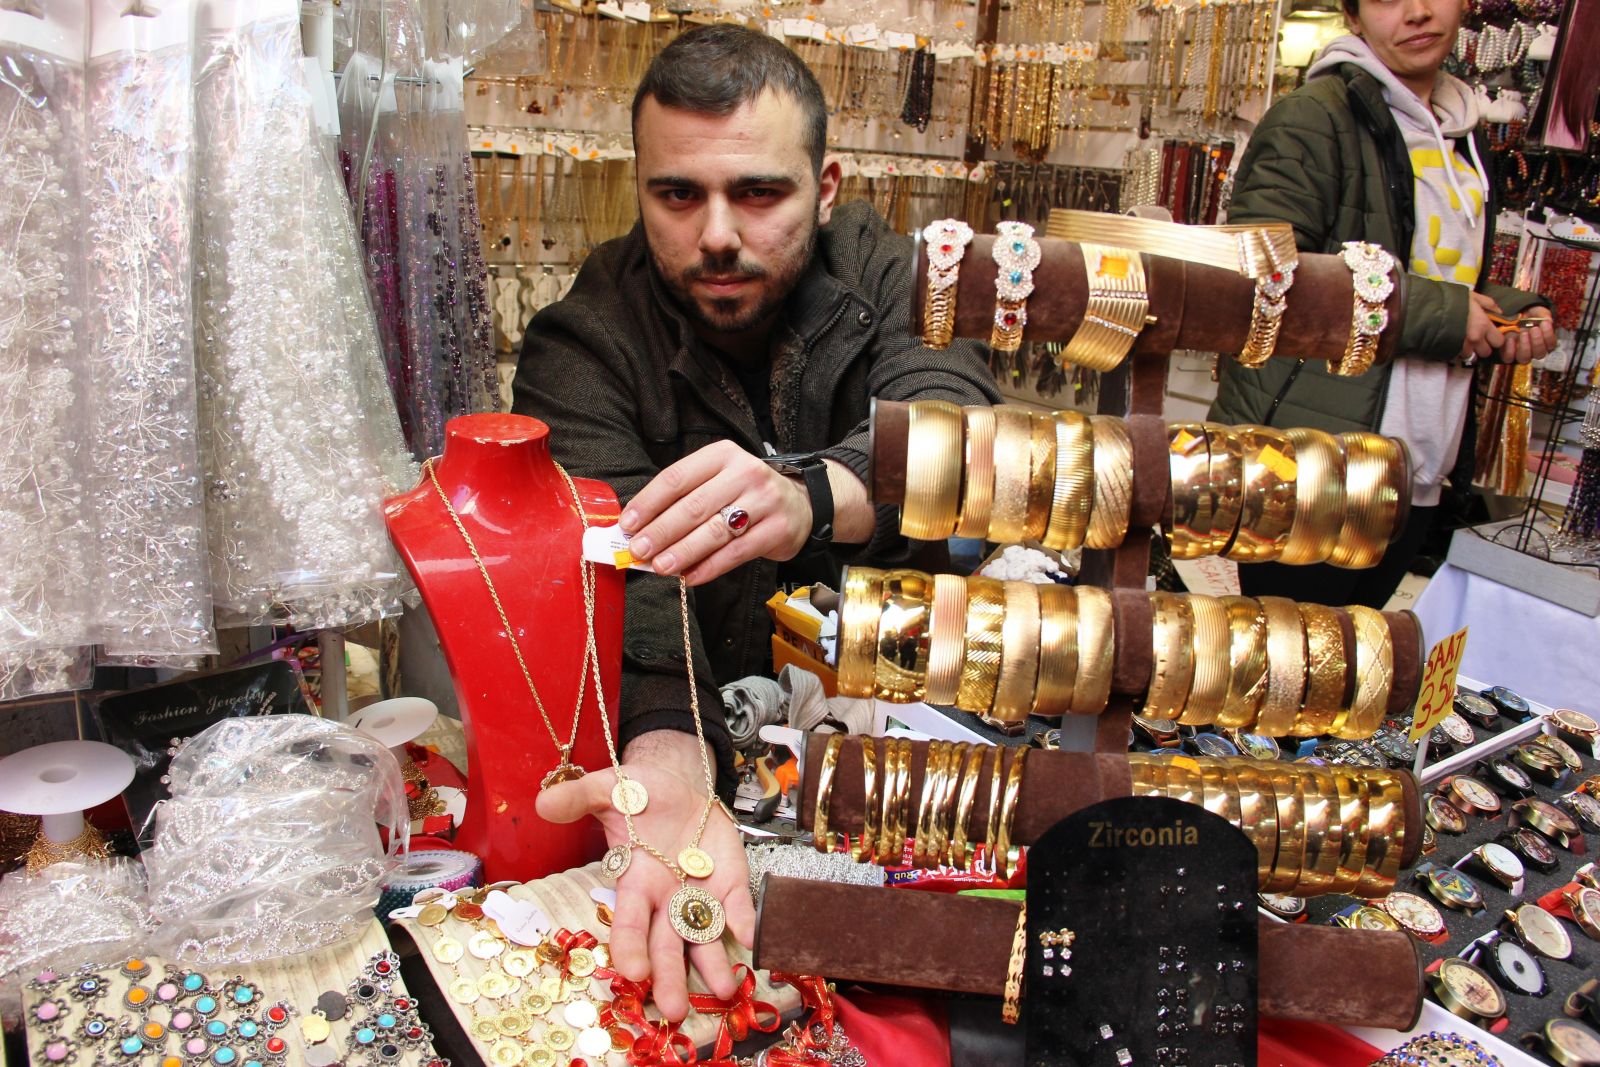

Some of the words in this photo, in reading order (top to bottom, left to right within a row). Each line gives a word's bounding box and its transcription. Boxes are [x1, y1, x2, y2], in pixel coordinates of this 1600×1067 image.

[1425, 631, 1467, 681] SAAT
[134, 706, 198, 725] Fashion
[1087, 819, 1199, 848] Zirconia
[894, 871, 914, 881] Rub
